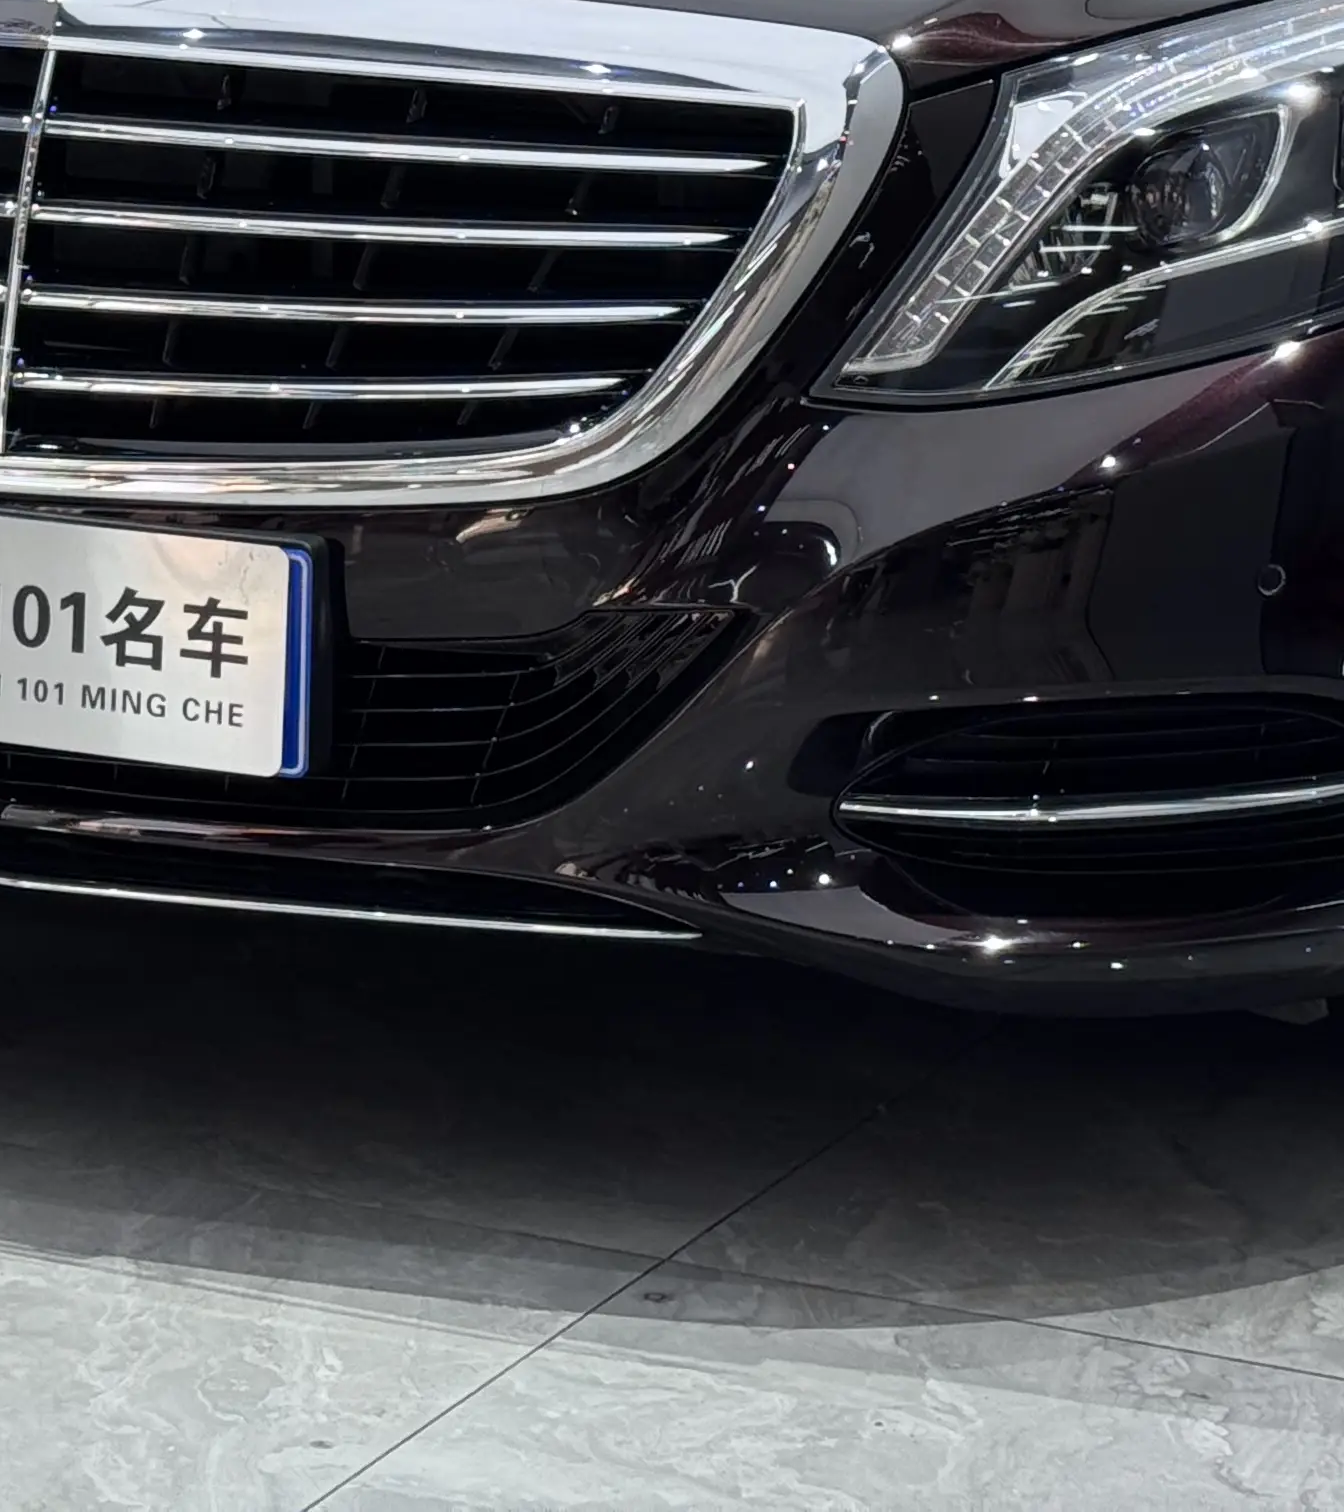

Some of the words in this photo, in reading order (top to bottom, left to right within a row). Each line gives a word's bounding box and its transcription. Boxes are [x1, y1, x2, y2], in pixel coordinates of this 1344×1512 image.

[17, 677, 64, 706] 101
[81, 684, 166, 718] MING
[182, 697, 244, 728] CHE
